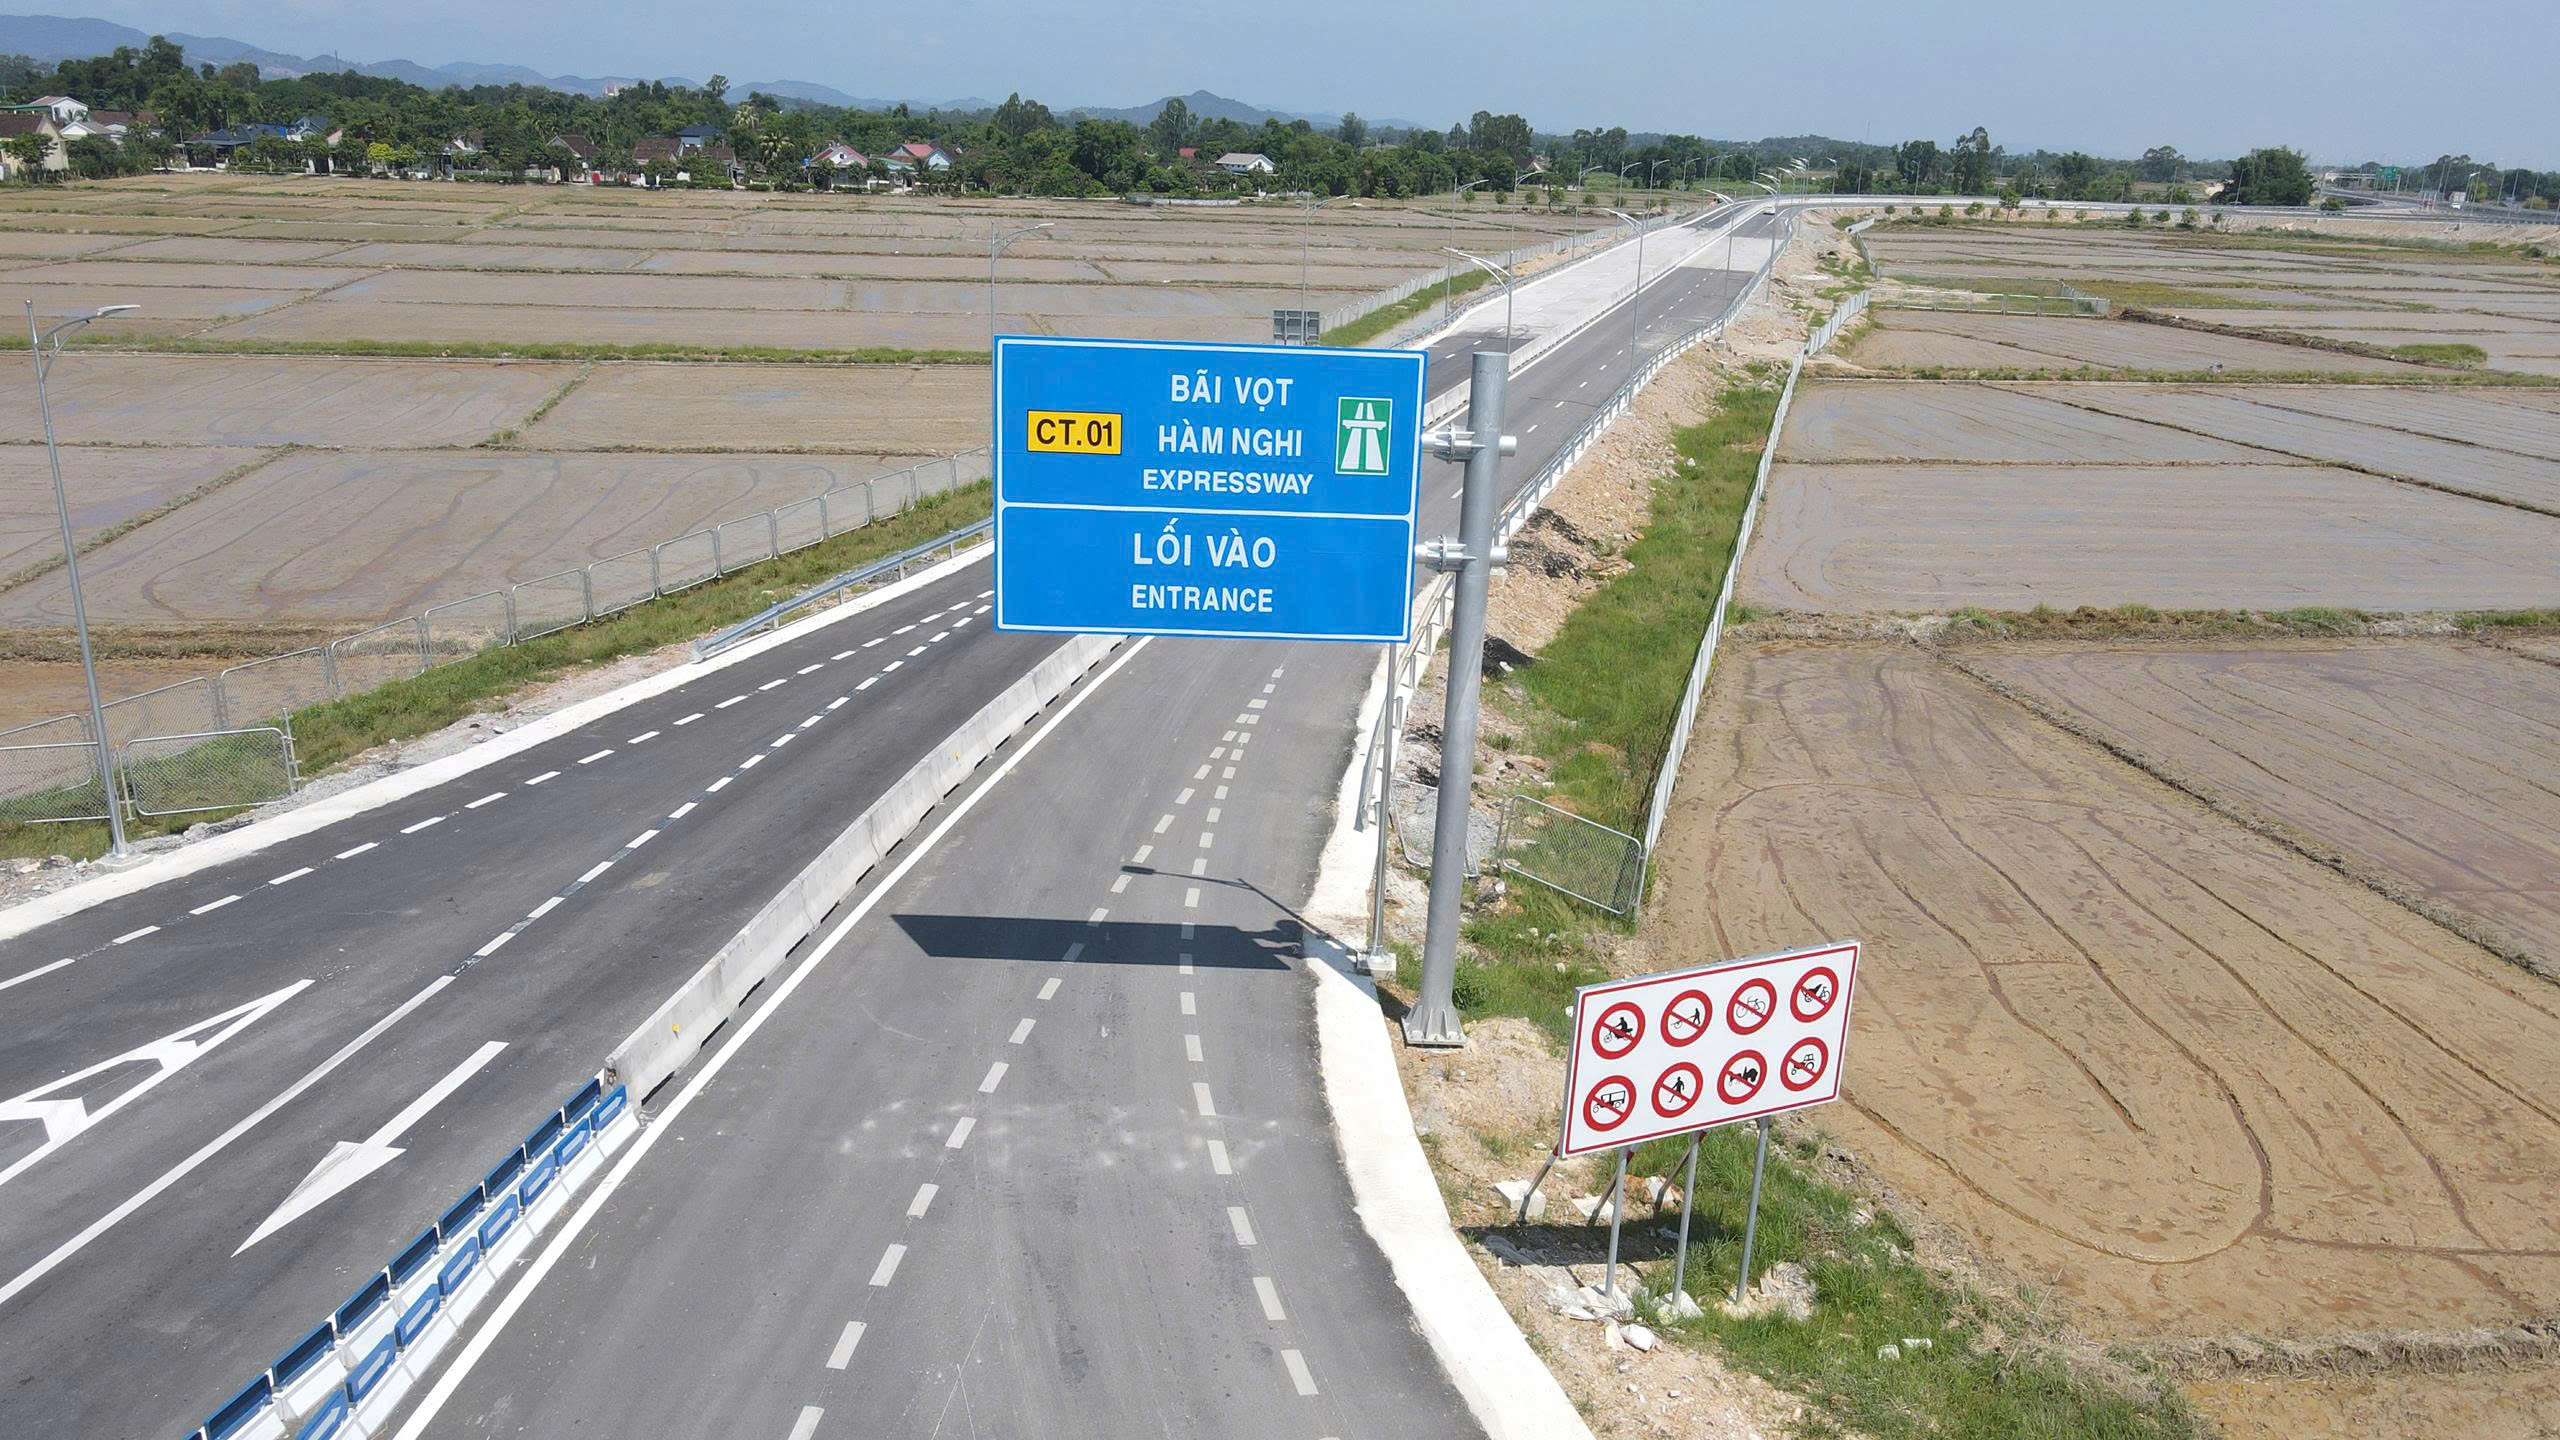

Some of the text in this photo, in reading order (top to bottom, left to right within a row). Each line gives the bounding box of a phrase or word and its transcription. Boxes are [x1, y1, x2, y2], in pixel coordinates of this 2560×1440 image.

[1171, 369, 1294, 412] BÃI VỌT
[1036, 419, 1113, 447] CT.01
[1159, 418, 1302, 457] HÀM NGHI
[1143, 469, 1314, 495] EXPRESSWAY
[1134, 518, 1276, 568] LỐI VÀO
[1132, 585, 1273, 613] ENTRANCE
